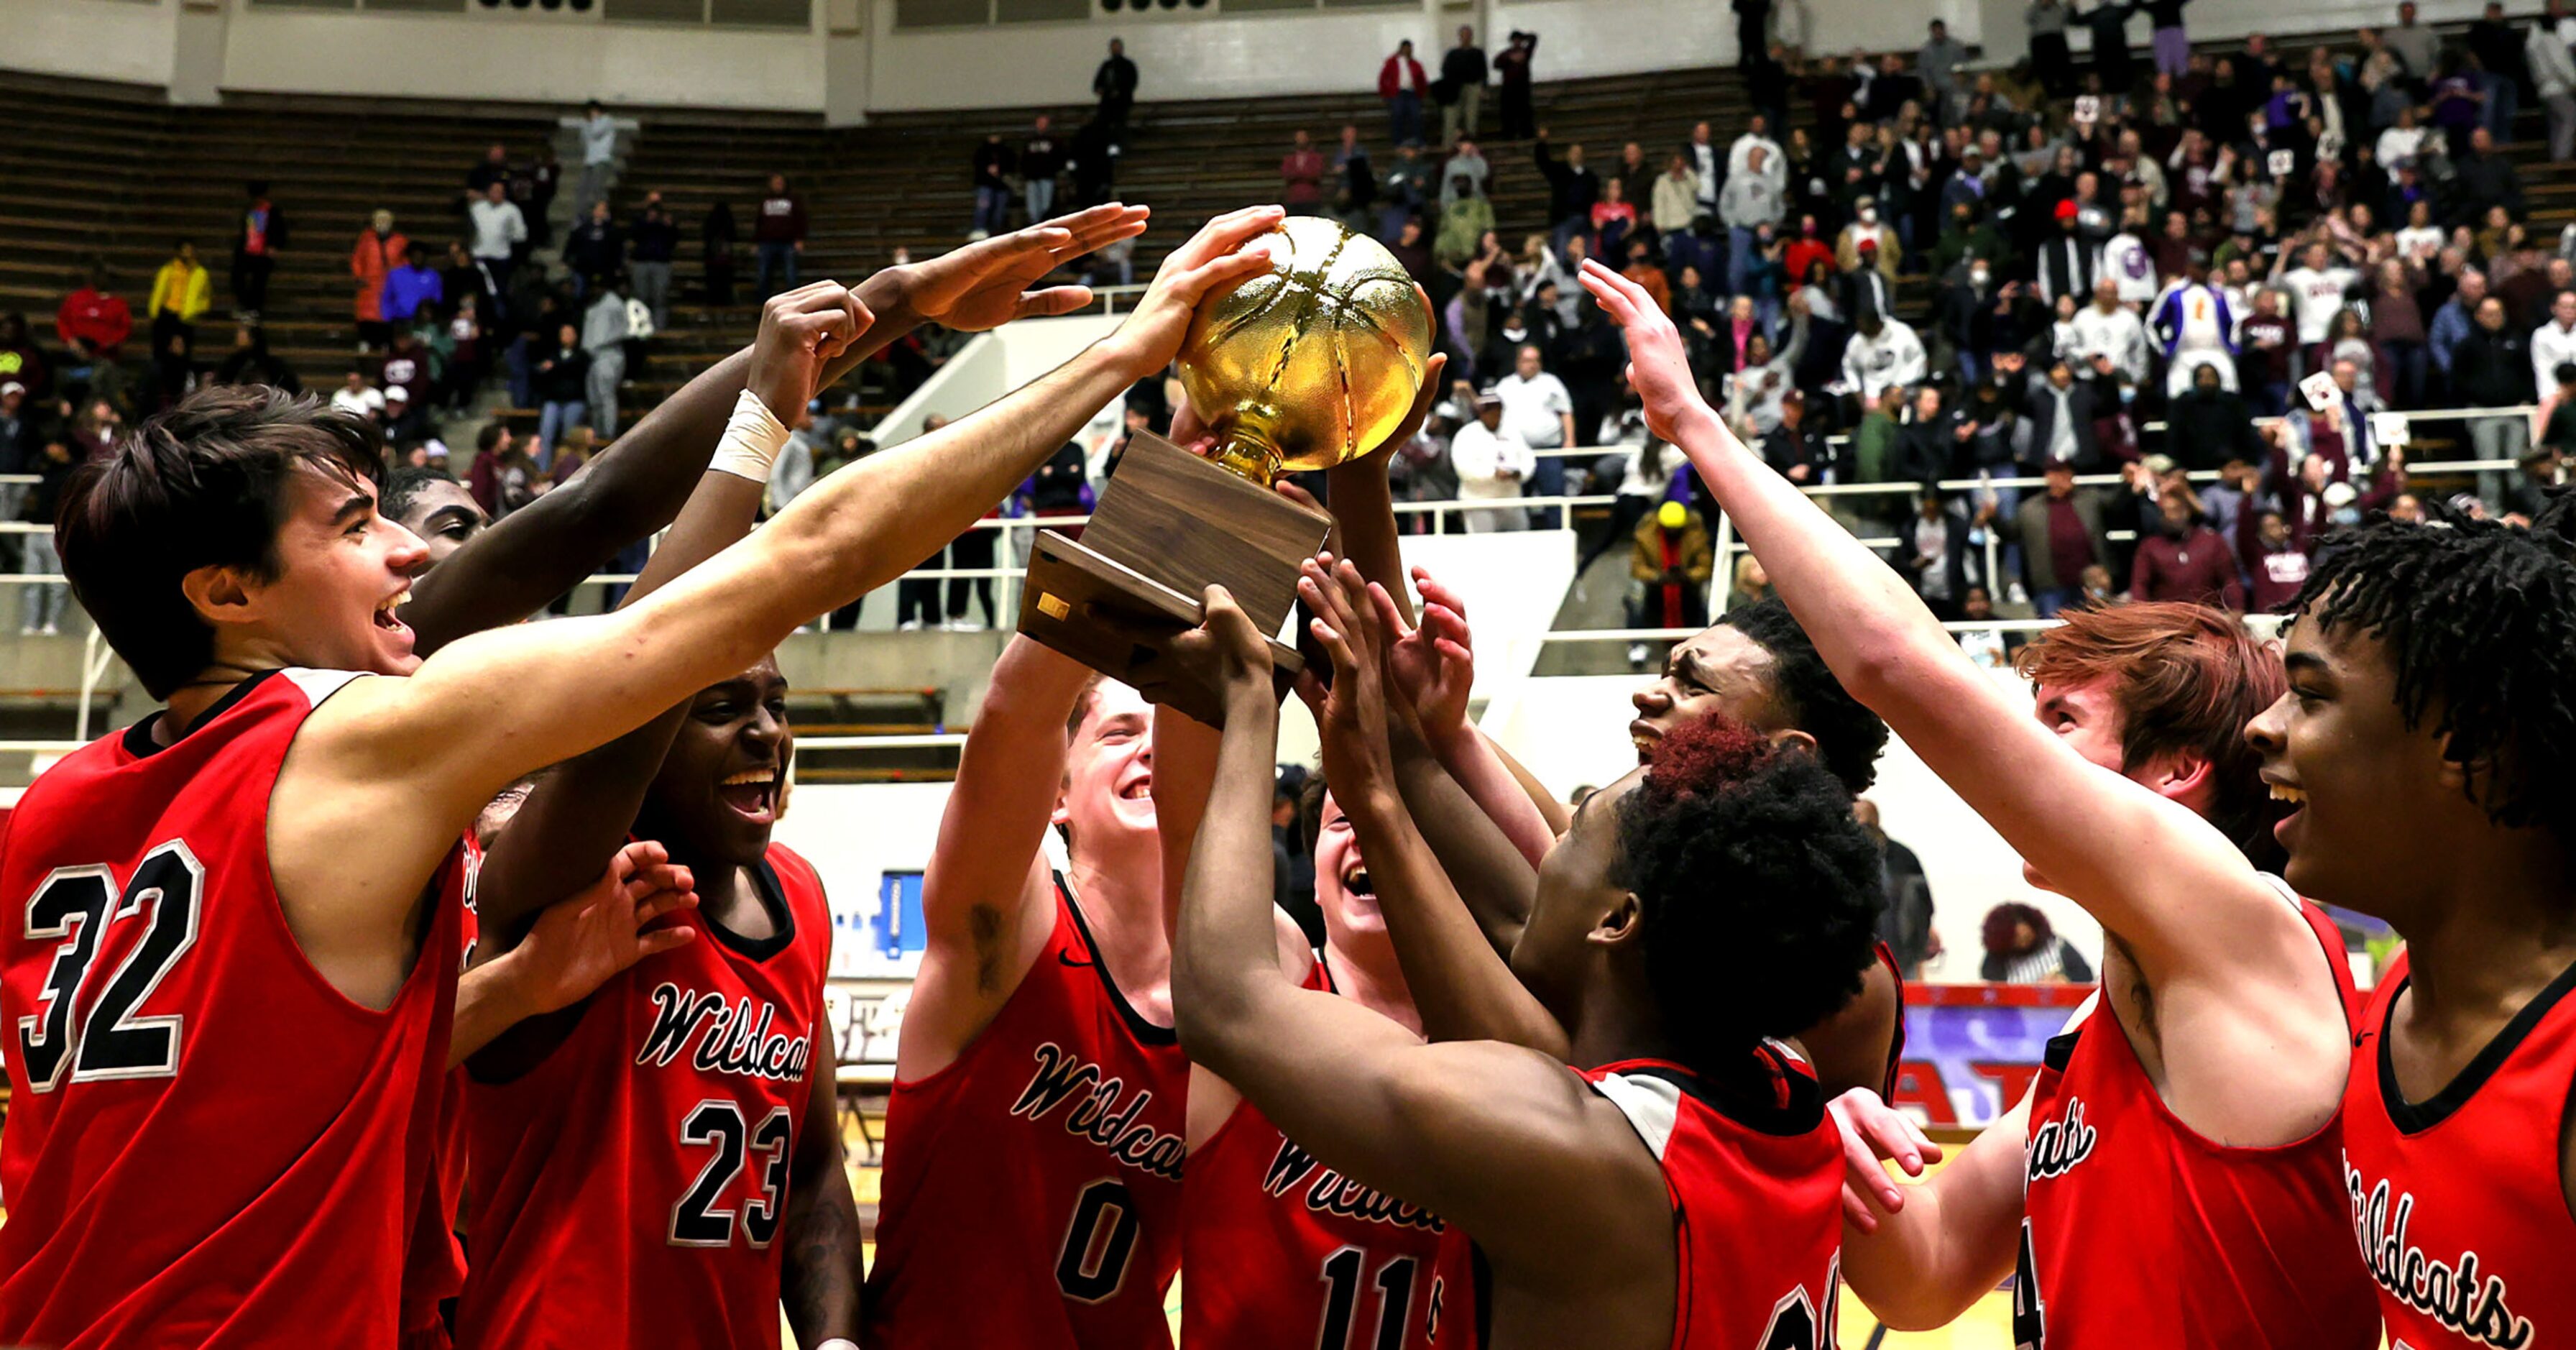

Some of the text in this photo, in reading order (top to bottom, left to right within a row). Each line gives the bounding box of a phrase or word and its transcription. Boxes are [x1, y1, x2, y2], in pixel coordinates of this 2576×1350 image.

[18, 837, 206, 1093] 32
[636, 982, 813, 1083] Wildca
[666, 1098, 792, 1249] 23
[1054, 1175, 1141, 1305] 0
[1315, 1244, 1420, 1350] 11
